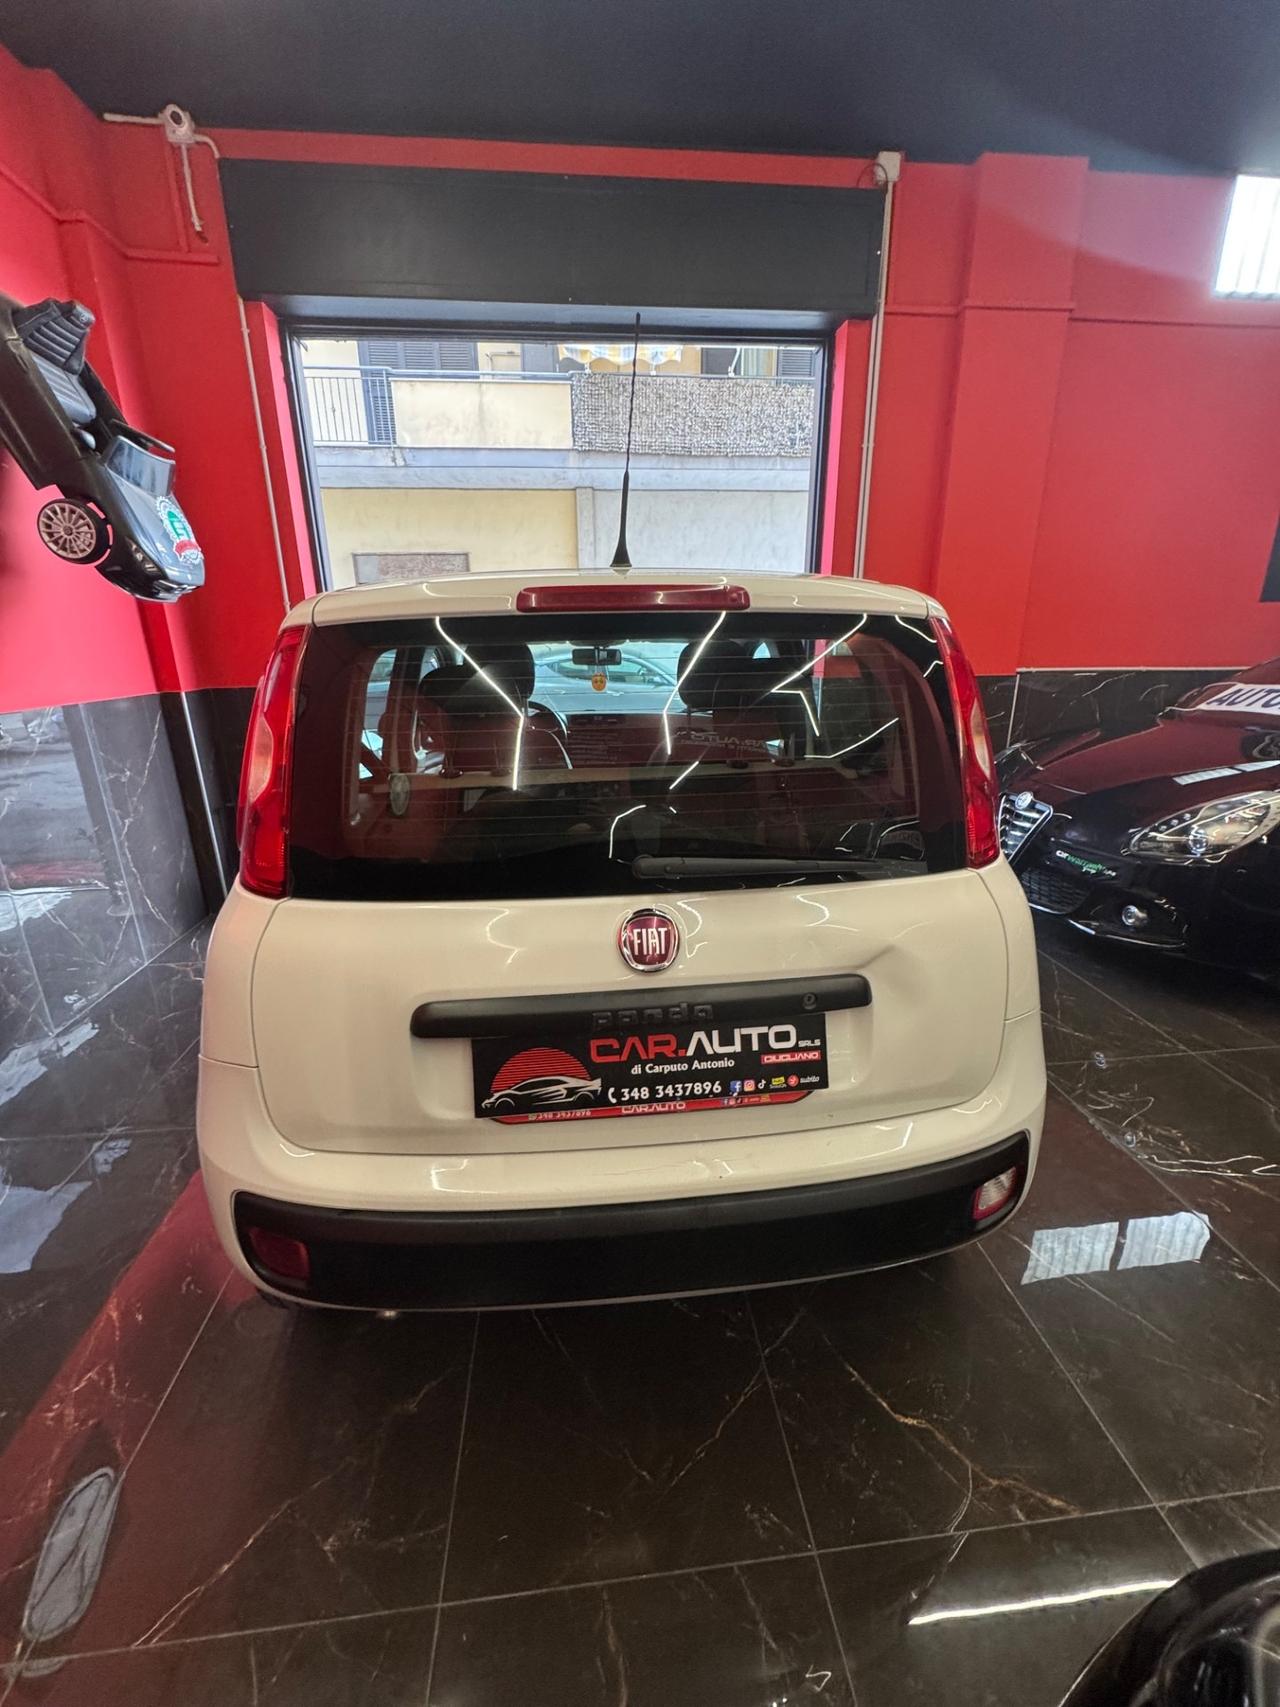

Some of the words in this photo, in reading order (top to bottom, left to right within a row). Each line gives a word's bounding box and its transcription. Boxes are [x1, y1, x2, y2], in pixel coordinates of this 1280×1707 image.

[633, 927, 667, 955] FIAT
[591, 1002, 713, 1032] panda
[590, 1024, 797, 1063] CAR.AUTO
[631, 1064, 642, 1075] di
[645, 1061, 688, 1075] Carputo
[692, 1057, 735, 1070] Antonio
[621, 1087, 650, 1101] 348
[655, 1081, 722, 1099] 3437896
